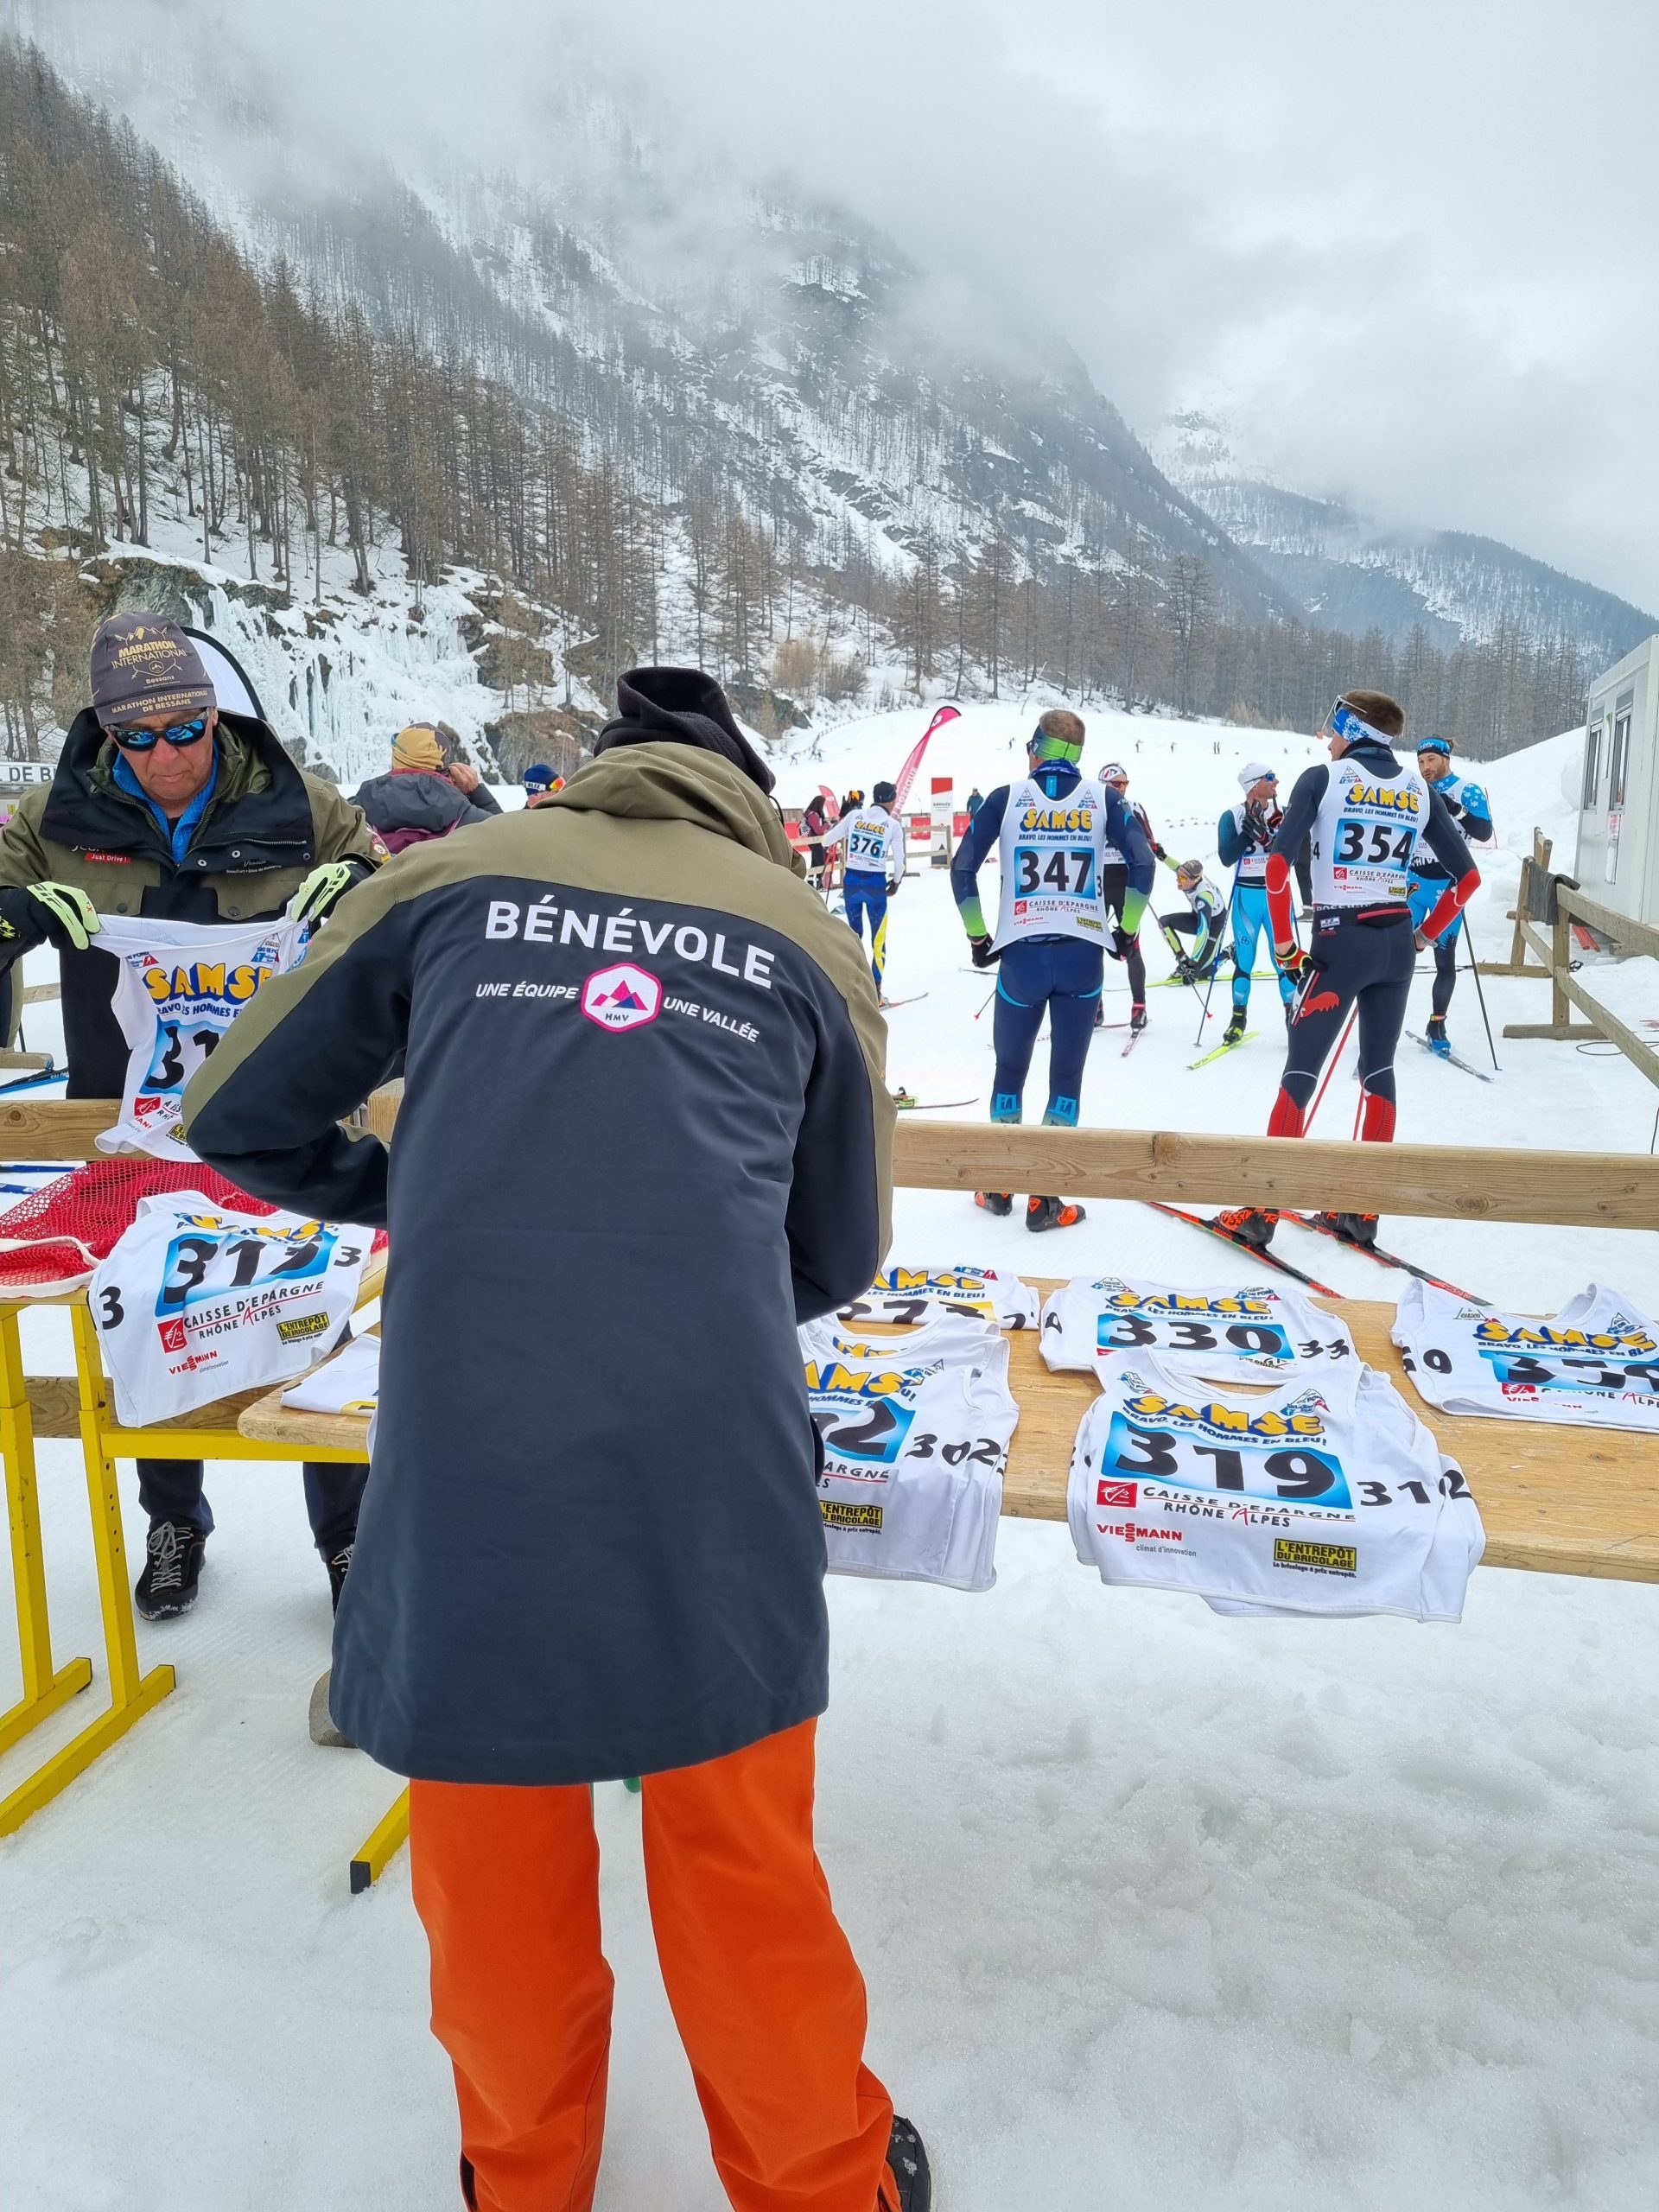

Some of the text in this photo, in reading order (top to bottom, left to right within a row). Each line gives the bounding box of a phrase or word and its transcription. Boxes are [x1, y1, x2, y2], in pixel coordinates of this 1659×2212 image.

[118, 640, 177, 658] MARATHON
[111, 649, 188, 670] INTERNATIONAL
[146, 675, 175, 684] Bessans
[111, 690, 208, 714] MARATHON INTERNATIONAL
[156, 699, 192, 709] BESSANS
[9, 766, 34, 782] DE
[1345, 784, 1420, 814] SAMSE
[1020, 808, 1092, 833] SAMSE
[1375, 810, 1397, 818] HOMMES
[850, 836, 881, 856] 376
[1338, 823, 1413, 868] 354
[1020, 850, 1092, 893] 347
[1058, 900, 1099, 912] D'EPARGNE
[485, 894, 775, 989] BÉNÉVOLE
[476, 980, 581, 1000] UNE ÉQUIPE
[193, 1002, 231, 1018] HOMMES
[604, 1012, 630, 1023] HMV
[663, 996, 760, 1044] UNE VALLÉE
[144, 1026, 220, 1090] 31
[334, 1245, 362, 1267] 3
[887, 1287, 934, 1298] HOMMES
[184, 1281, 325, 1329] CAISSE D'EPARGNE
[1105, 1294, 1272, 1314] SAMSE
[200, 1305, 282, 1339] RHÔNE ALPES
[279, 1314, 326, 1332] L'ENTREPÔT
[1167, 1310, 1218, 1319] HOMMES
[292, 1322, 328, 1336] BRICOLAGE
[1109, 1314, 1282, 1354] 330
[1472, 1323, 1658, 1351] SAMSE
[1478, 1341, 1524, 1350] BRAVO,
[168, 1350, 218, 1376] VIESSMANN
[1123, 1395, 1325, 1437] SAMSE
[1122, 1407, 1168, 1424] BRAVO,
[1173, 1420, 1196, 1428] LES
[1198, 1423, 1259, 1444] HOMMES
[1285, 1437, 1328, 1447] BLEU!
[905, 1433, 1001, 1466] 302
[824, 1461, 890, 1479] ARGNE
[1116, 1423, 1335, 1498] 319
[823, 1503, 880, 1518] 'ENTREPÔT
[1143, 1487, 1356, 1520] CAISSE D'EPARGNE
[830, 1514, 880, 1526] BRICOLAGE
[1164, 1502, 1290, 1528] RHÔNE ALPES
[1096, 1522, 1183, 1543] VIESSMANN
[1136, 1544, 1197, 1557] climat d'innovation
[1277, 1541, 1354, 1560] L'ENTREPÔT
[1277, 1551, 1354, 1569] DU BRICOLAGE
[1281, 1561, 1309, 1573] bricolage
[1314, 1567, 1328, 1576] prix
